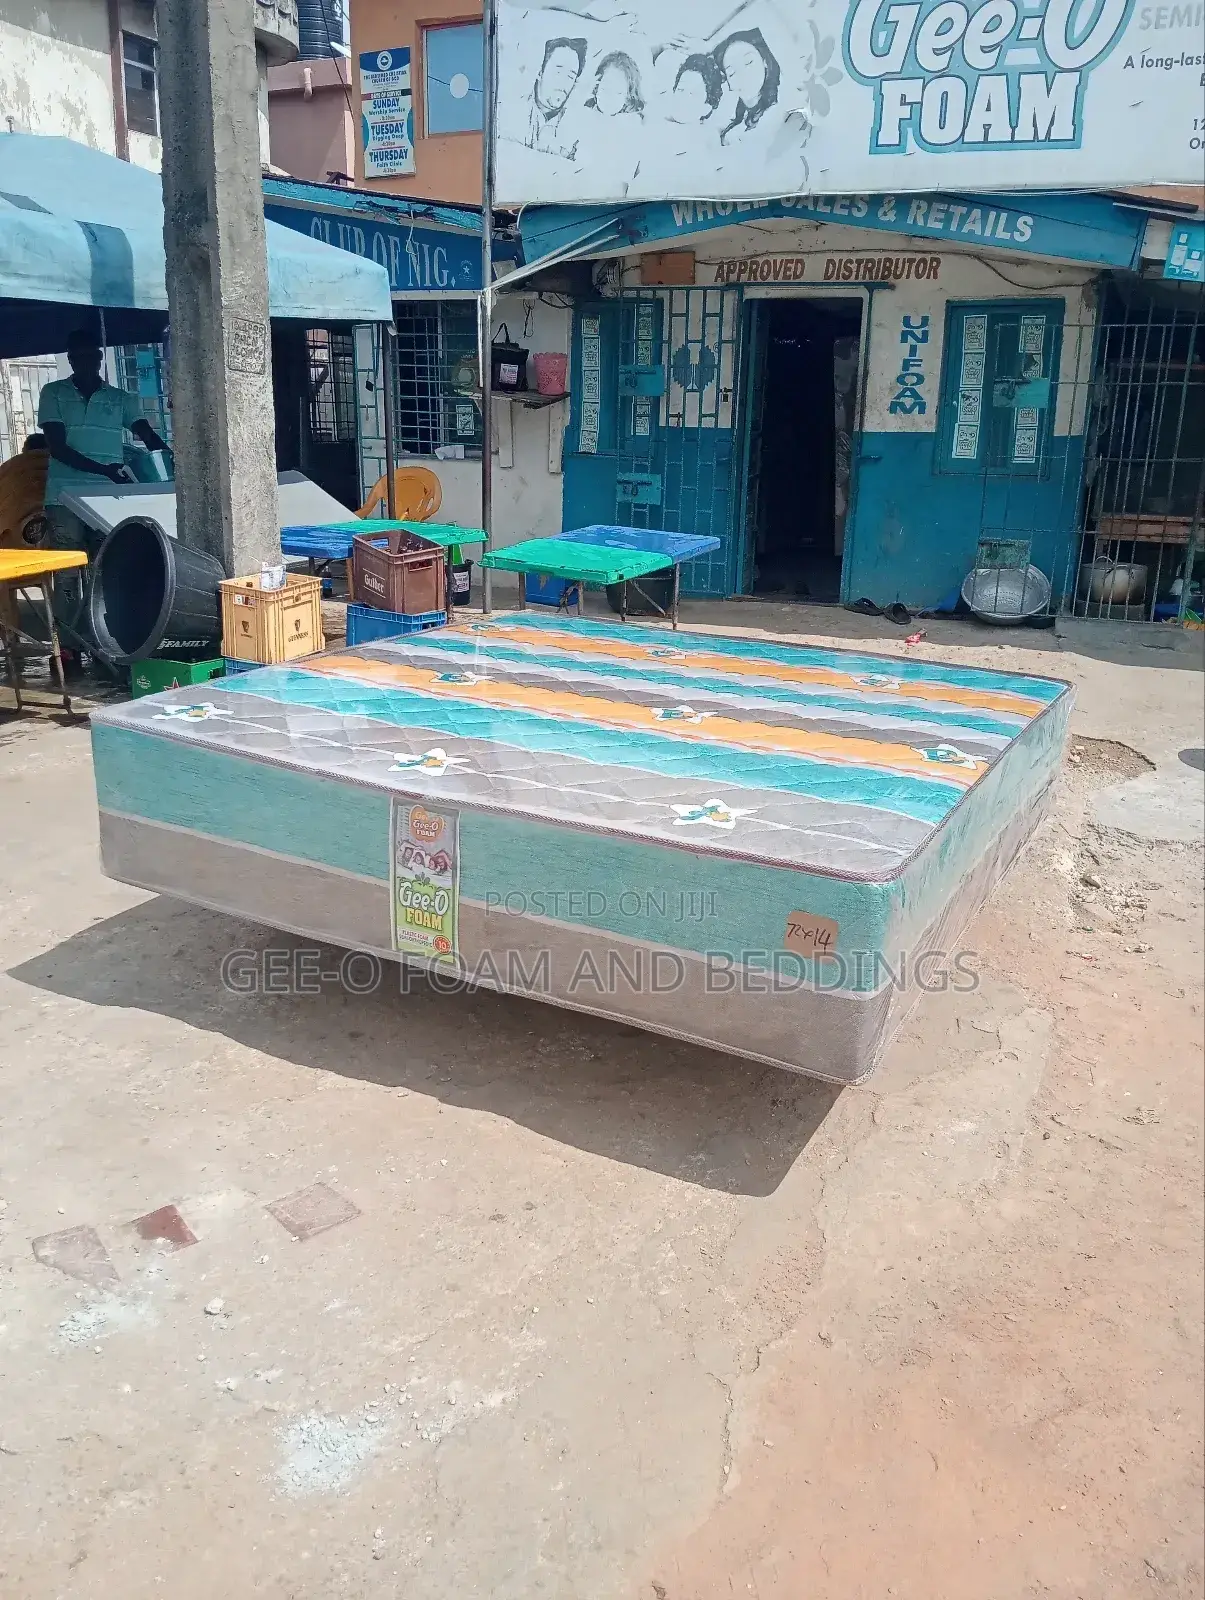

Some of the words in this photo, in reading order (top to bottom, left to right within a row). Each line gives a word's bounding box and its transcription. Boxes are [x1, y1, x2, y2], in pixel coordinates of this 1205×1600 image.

[849, 0, 1128, 78] Gee-O
[1123, 55, 1135, 69] A
[373, 98, 400, 109] SUNDAY
[874, 70, 1083, 150] FOAM
[371, 122, 404, 136] TUESDAY
[369, 149, 408, 163] THURSDAY
[907, 199, 1034, 242] RETAILS
[372, 232, 400, 287] OF
[407, 240, 456, 287] NIG.
[714, 257, 806, 283] APPROVED
[823, 257, 941, 281] DISTRIBUTOR
[889, 315, 930, 415] UNIFOAM
[364, 574, 384, 593] Gulder
[413, 820, 439, 831] Gee-O
[399, 881, 449, 916] Gee-O
[406, 907, 443, 931] FOAM
